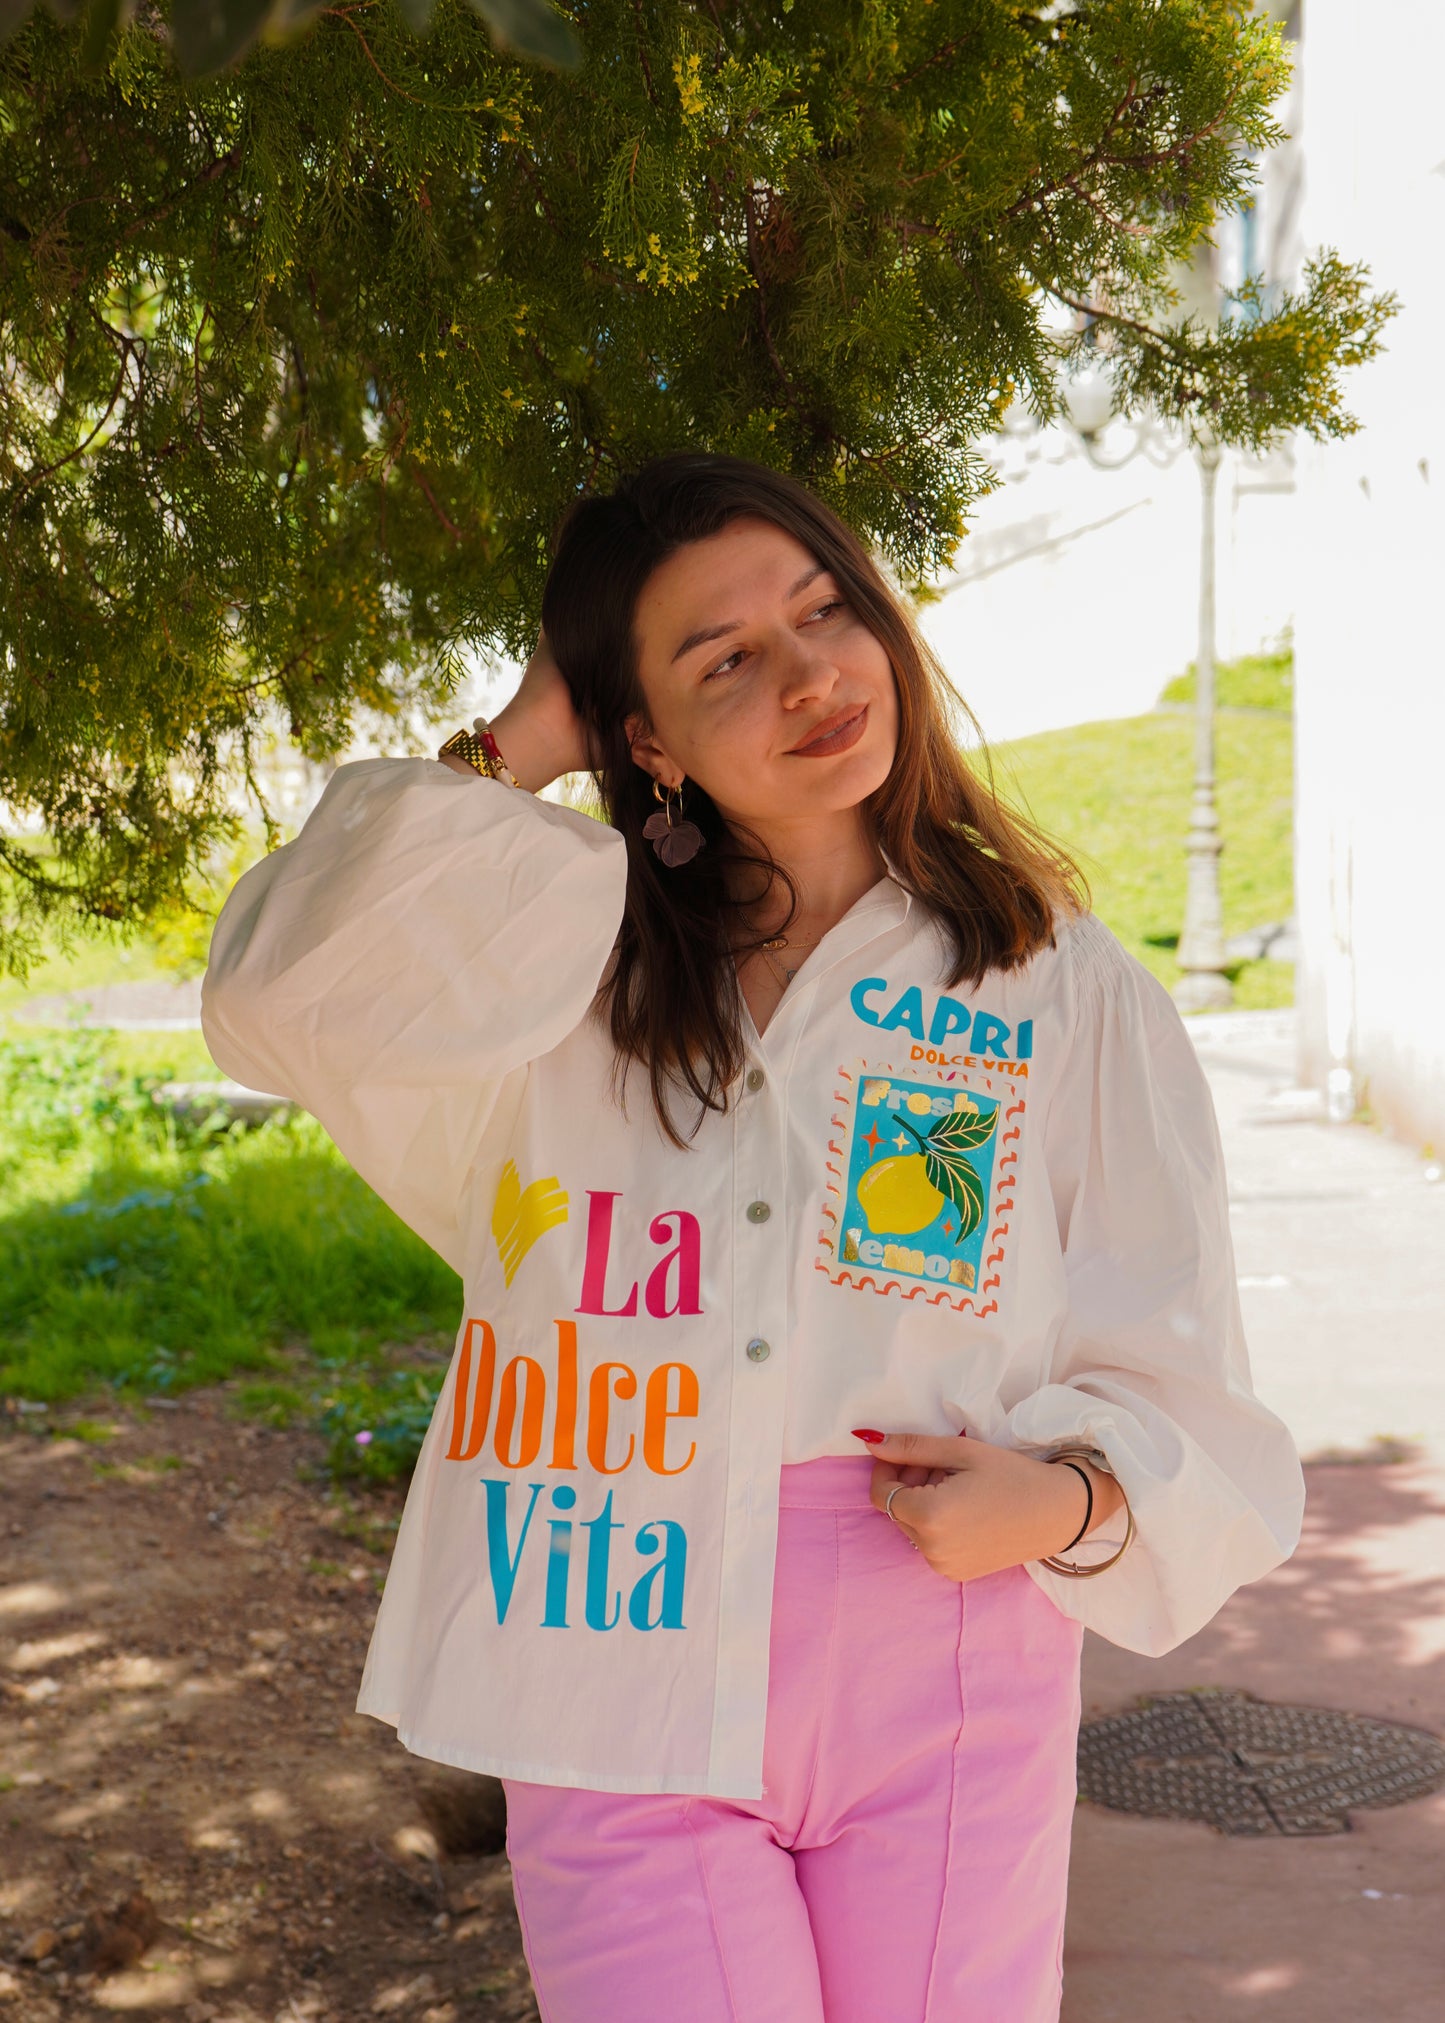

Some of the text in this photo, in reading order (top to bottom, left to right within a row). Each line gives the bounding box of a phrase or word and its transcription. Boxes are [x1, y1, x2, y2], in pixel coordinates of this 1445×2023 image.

[850, 977, 1033, 1059] CAPRI
[910, 1045, 1029, 1079] DOLCE VITA
[862, 1079, 979, 1117] Fresh
[574, 1190, 704, 1318] La
[445, 1319, 699, 1476] Dolce
[480, 1479, 688, 1631] Vita
